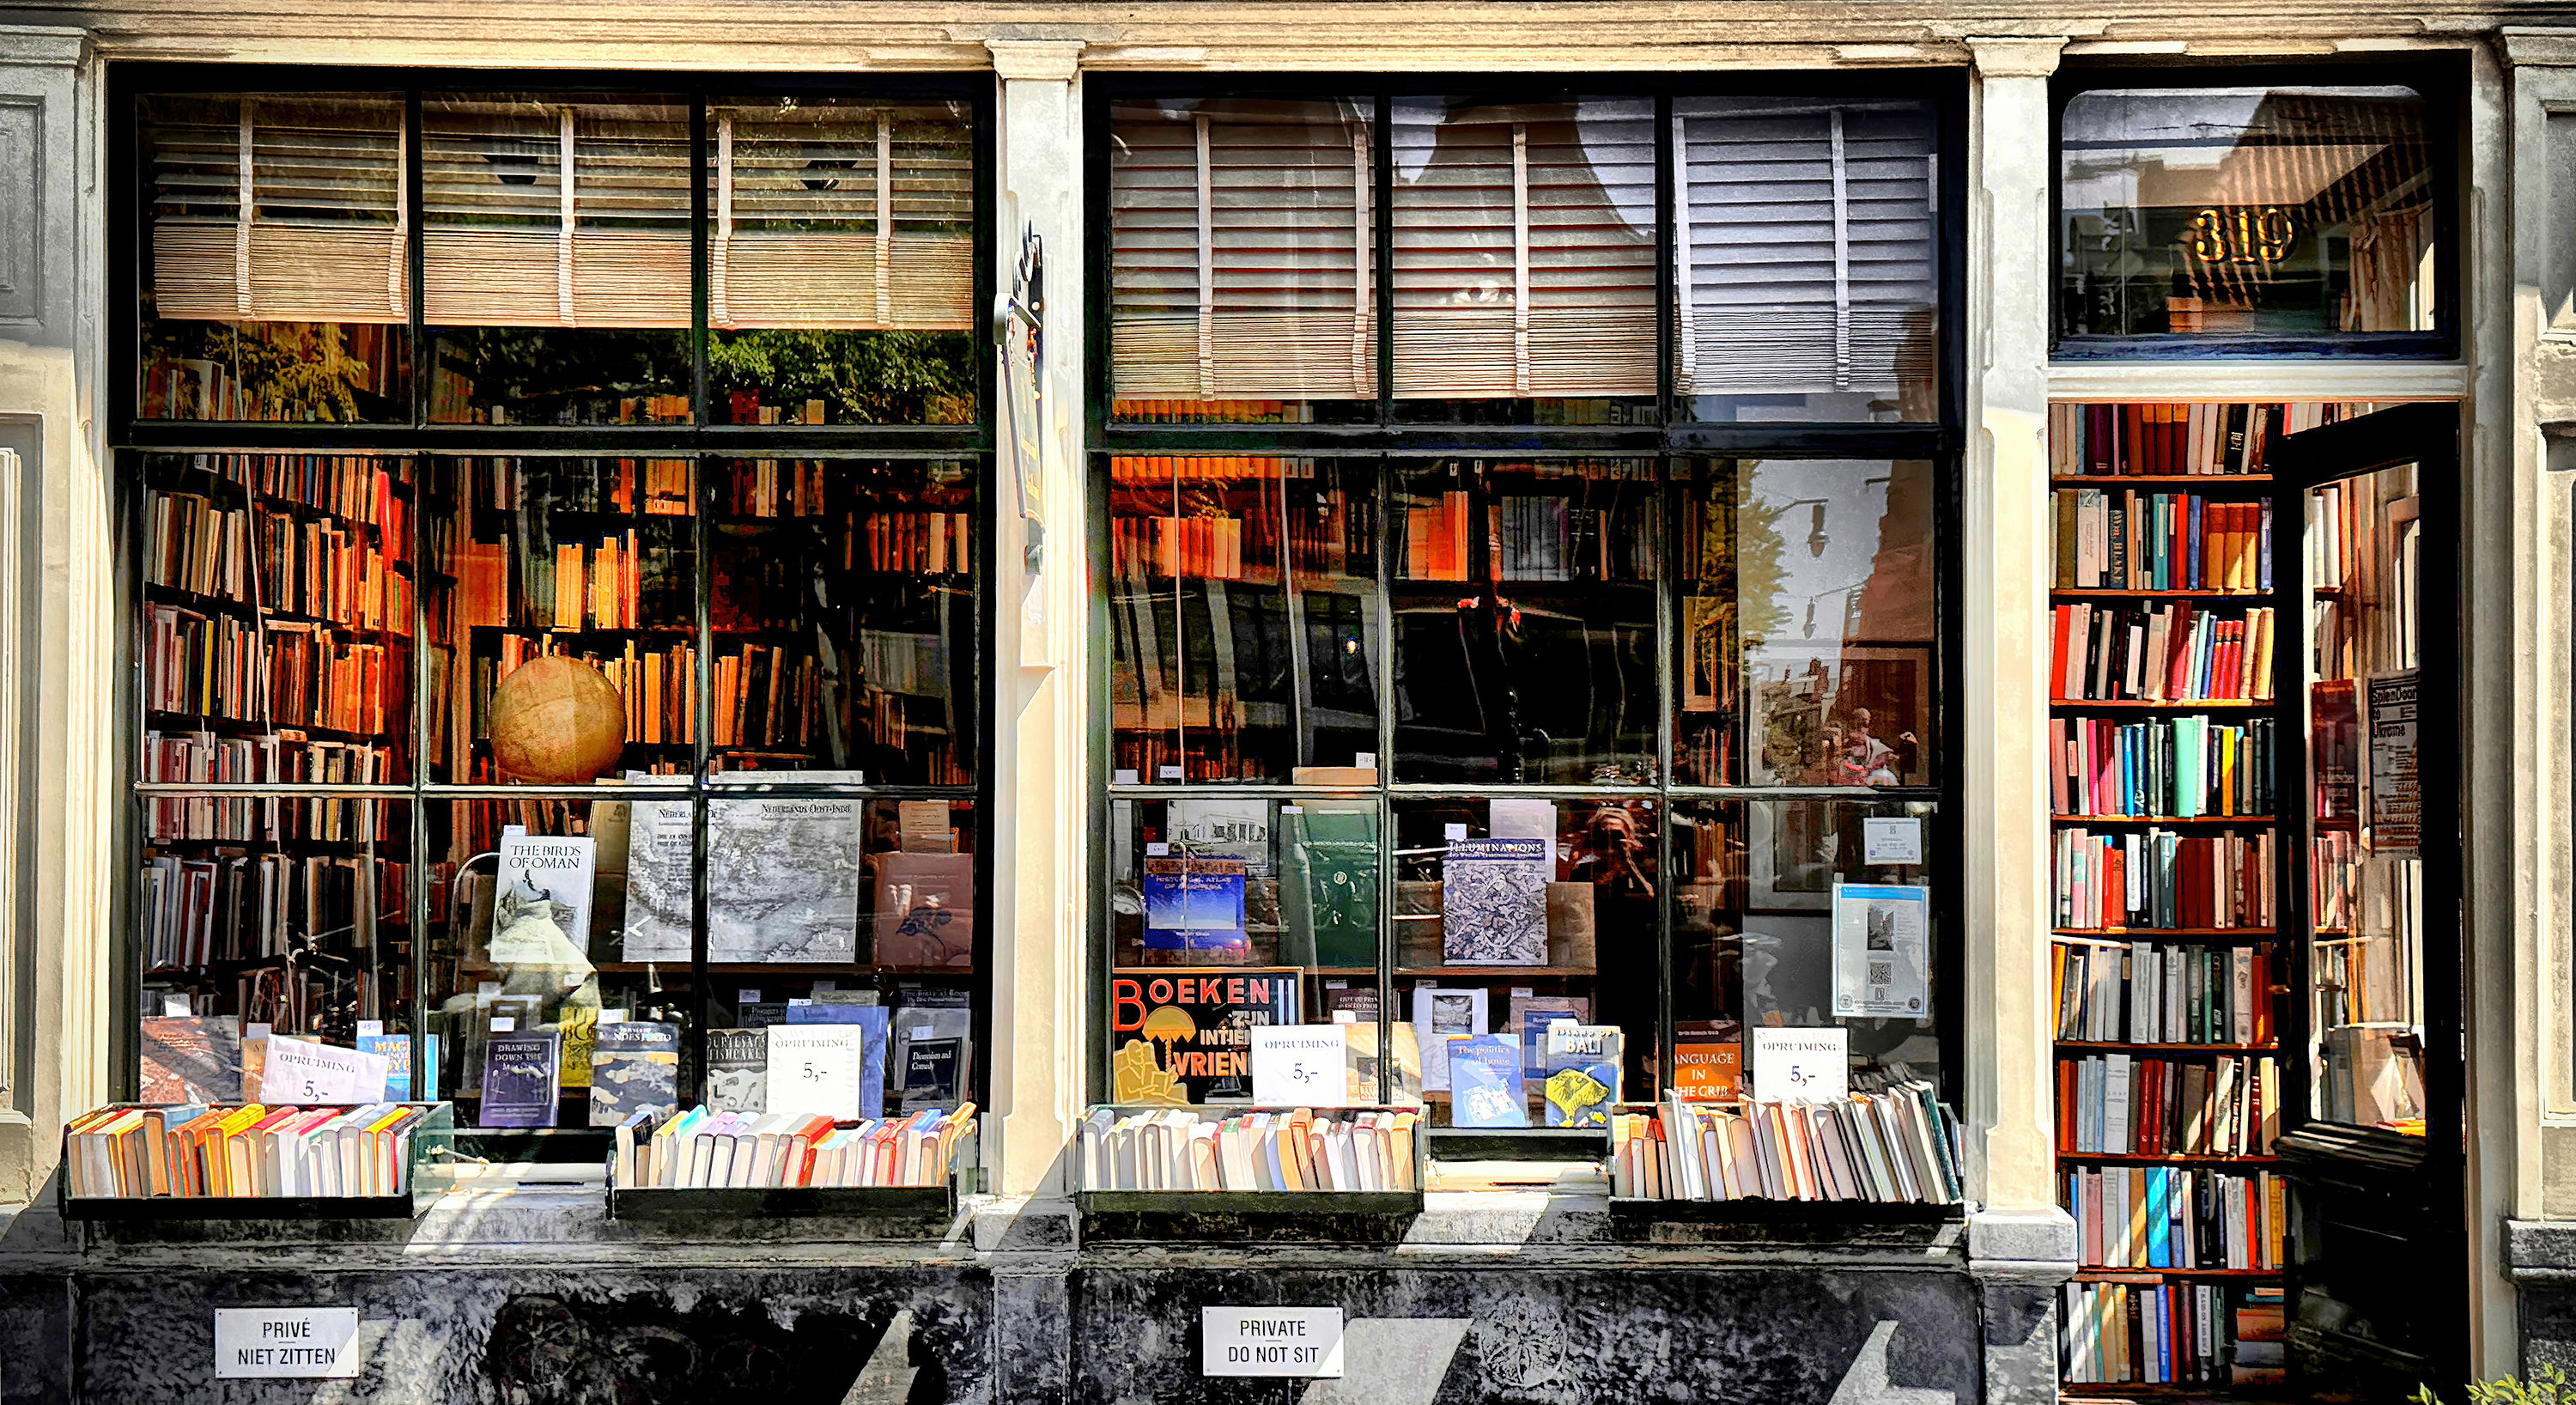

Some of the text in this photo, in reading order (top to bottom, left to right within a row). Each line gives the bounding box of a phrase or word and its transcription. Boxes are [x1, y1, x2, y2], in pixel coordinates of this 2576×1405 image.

[2196, 208, 2297, 263] 319
[510, 845, 581, 857] THE BIRDS
[1449, 842, 1542, 852] ILLUMINATIONS
[509, 857, 580, 869] OF OMAN
[1112, 978, 1269, 1031] BOEKEN
[775, 1039, 848, 1049] OPRUIMING
[1265, 1040, 1339, 1049] OPRUIMING
[1565, 1036, 1603, 1055] BALI
[1763, 1042, 1837, 1051] OPRUIMING
[279, 1053, 355, 1074] OPRUIMING
[803, 1061, 828, 1083] 5,-
[1293, 1062, 1318, 1084] 5,-
[1692, 1068, 1706, 1080] IN
[1790, 1065, 1816, 1086] 5,-
[303, 1080, 329, 1102] 5,-
[263, 1317, 311, 1338] PRIVÉ
[1240, 1320, 1306, 1336] PRIVATE
[238, 1347, 336, 1365] NIET ZITTEN
[1228, 1346, 1320, 1364] DO NOT SIT
